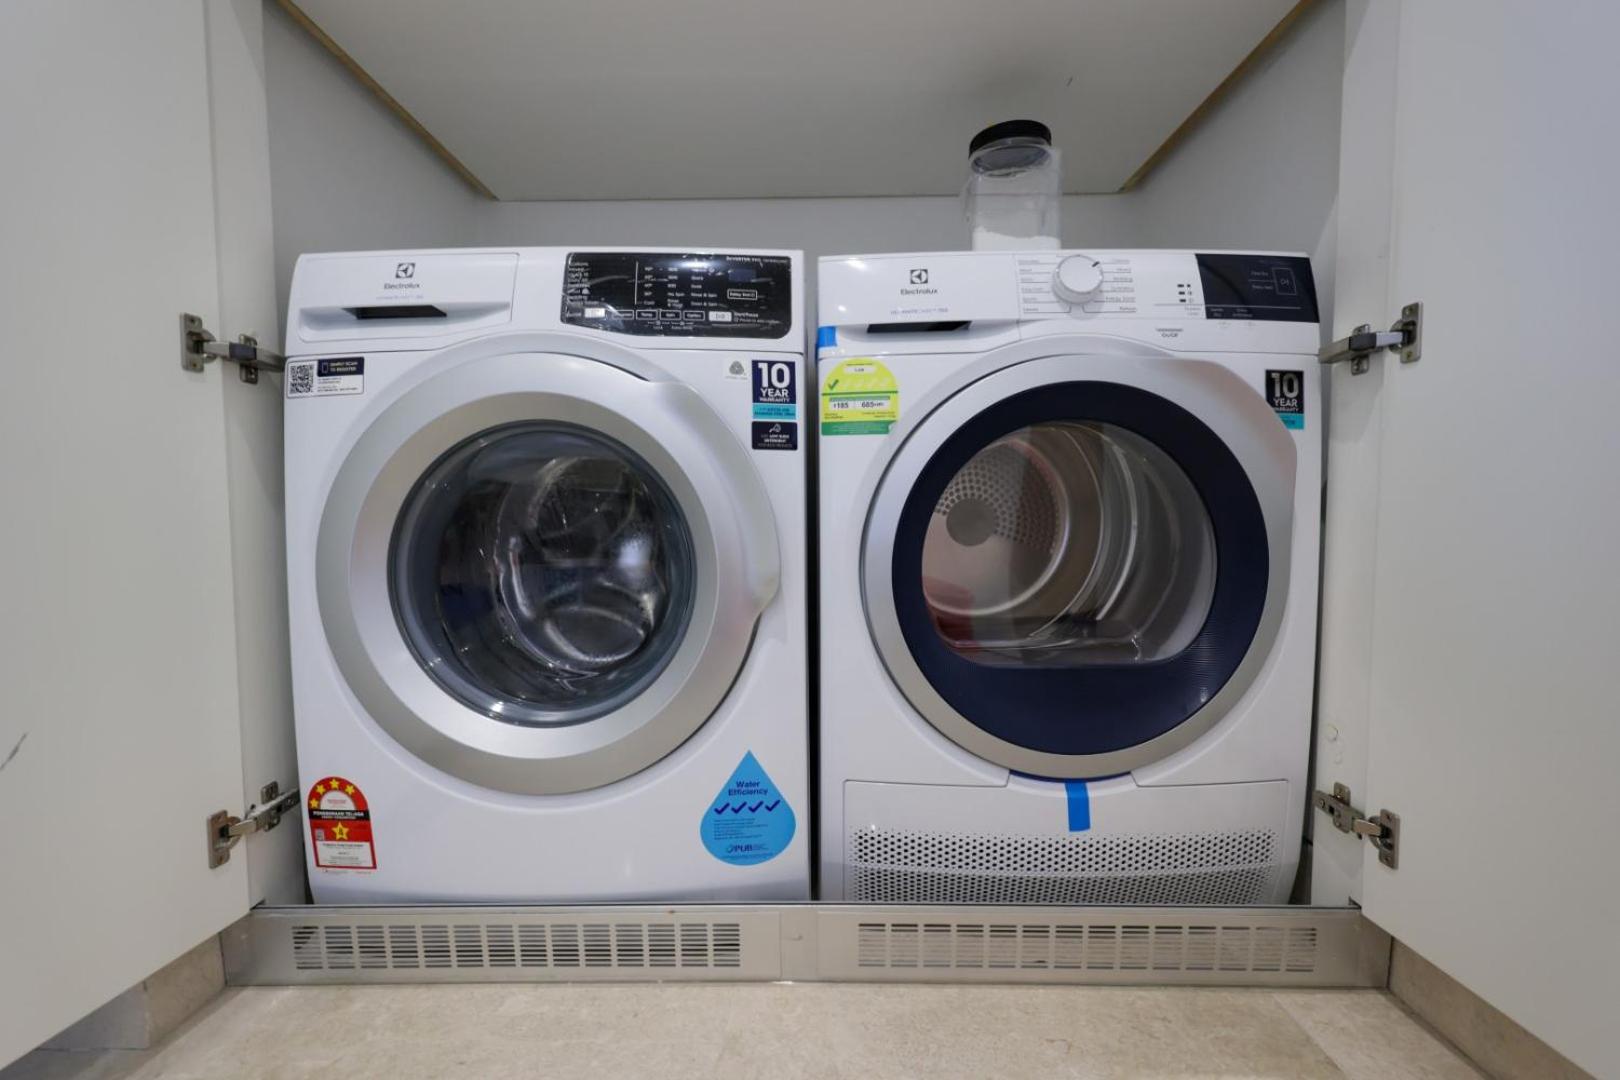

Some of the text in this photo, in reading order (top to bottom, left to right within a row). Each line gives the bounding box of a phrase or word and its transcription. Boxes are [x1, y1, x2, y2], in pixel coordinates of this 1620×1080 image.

[900, 288, 938, 296] Electrolux
[758, 362, 791, 389] 10
[1271, 372, 1299, 399] 10
[760, 388, 789, 398] YEAR
[1273, 398, 1298, 407] YEAR
[736, 780, 760, 788] Water
[728, 788, 768, 797] Efficiency
